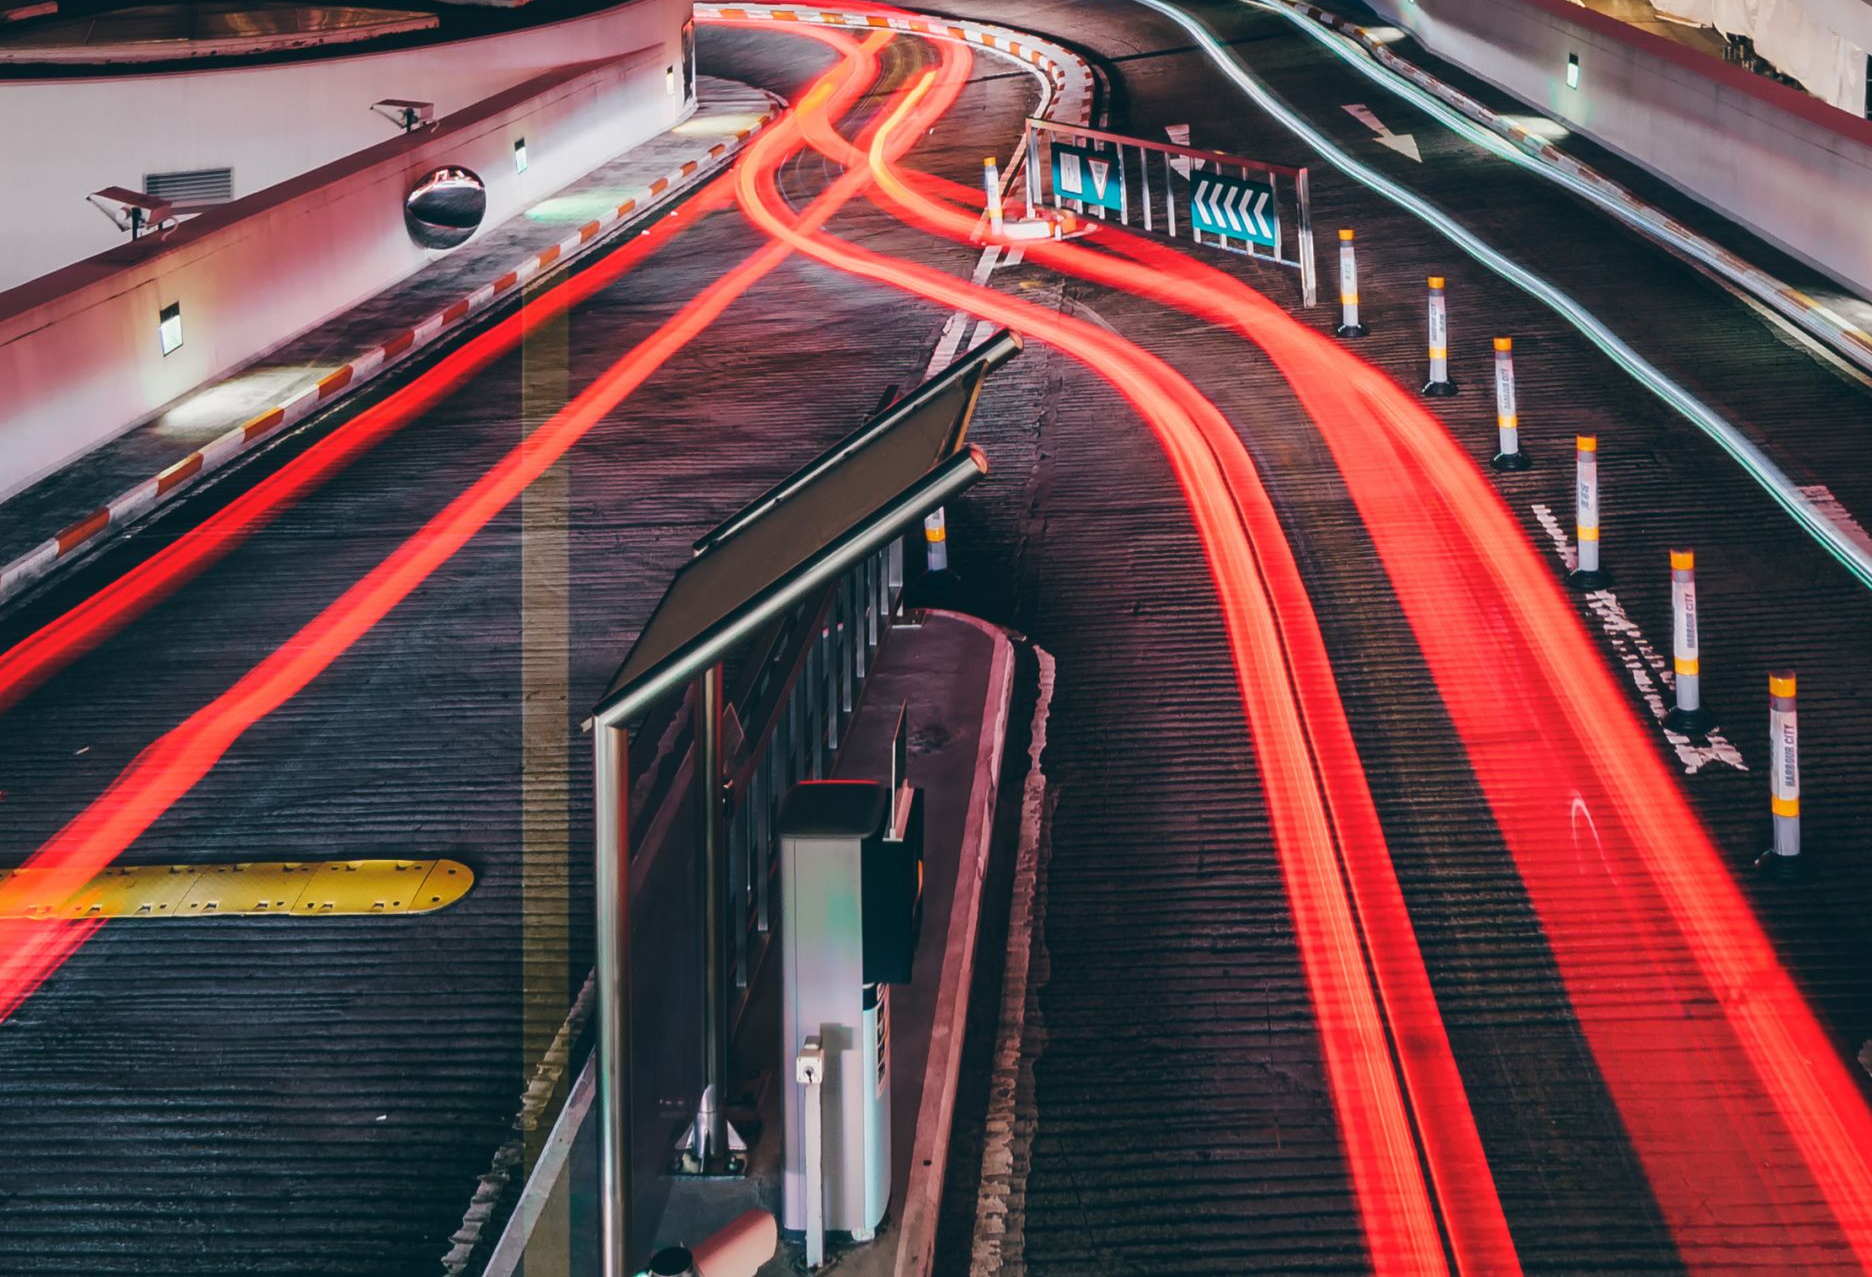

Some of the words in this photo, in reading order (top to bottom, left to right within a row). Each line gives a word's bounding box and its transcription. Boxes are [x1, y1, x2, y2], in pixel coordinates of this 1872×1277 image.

[1684, 592, 1694, 612] CITY
[1685, 612, 1696, 649] HARBOUR
[1783, 724, 1795, 745] CITY
[1784, 747, 1796, 787] HARBOUR
